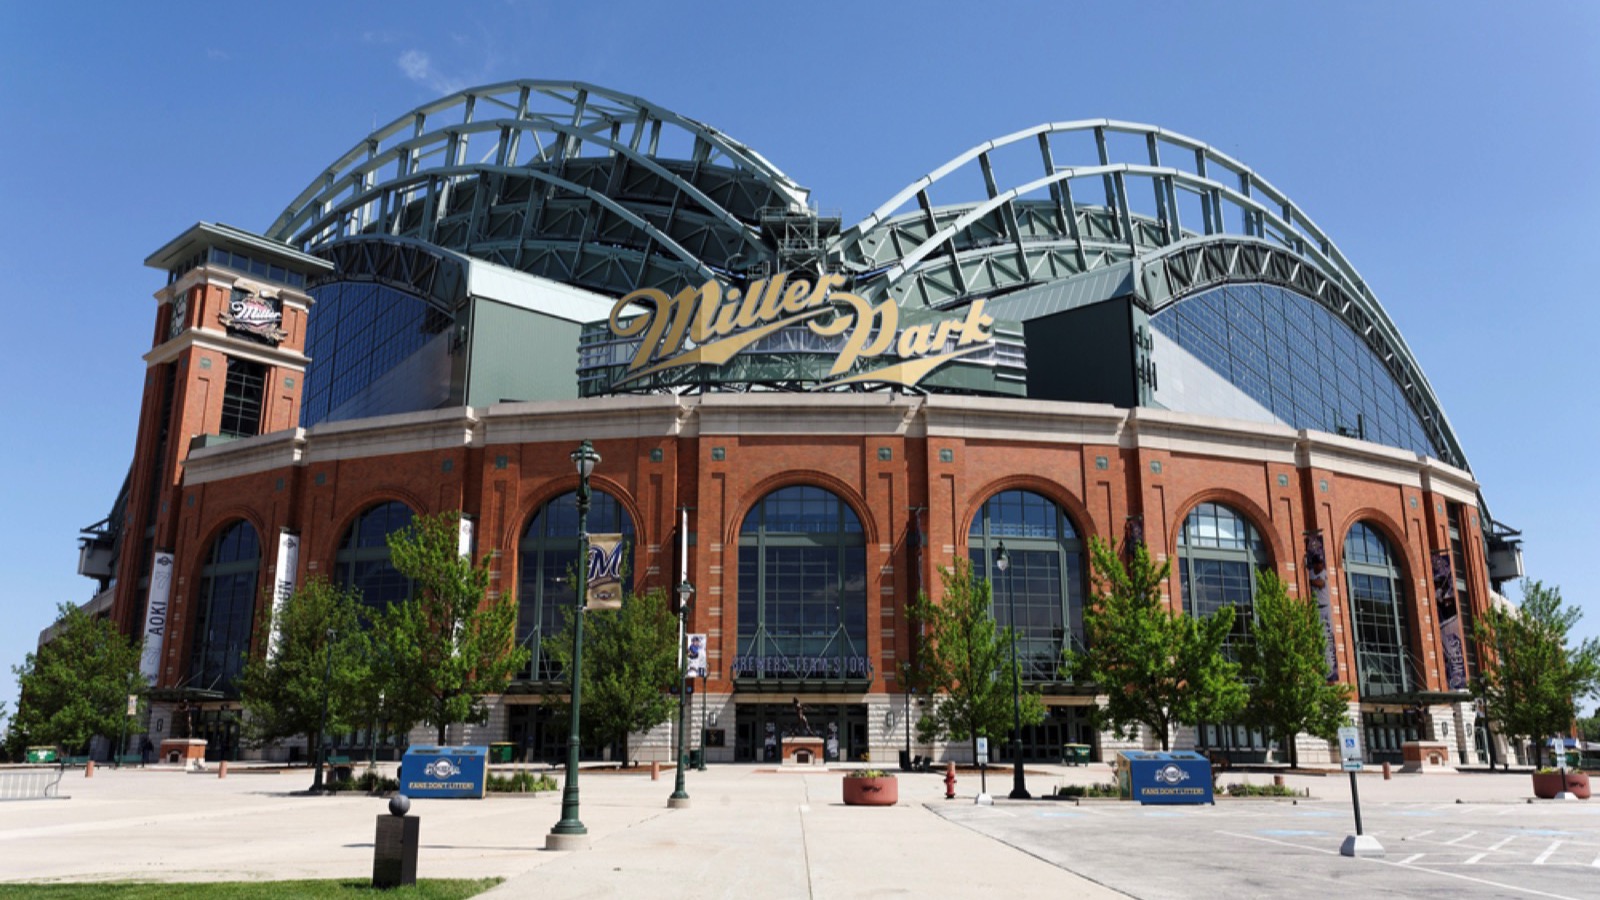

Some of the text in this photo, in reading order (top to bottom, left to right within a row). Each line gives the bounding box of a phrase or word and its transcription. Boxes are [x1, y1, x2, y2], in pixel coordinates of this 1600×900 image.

[231, 301, 282, 322] Miller
[609, 271, 997, 382] Miller Park
[149, 601, 167, 636] AOKI
[732, 656, 873, 673] BREWERS TEAM STORE
